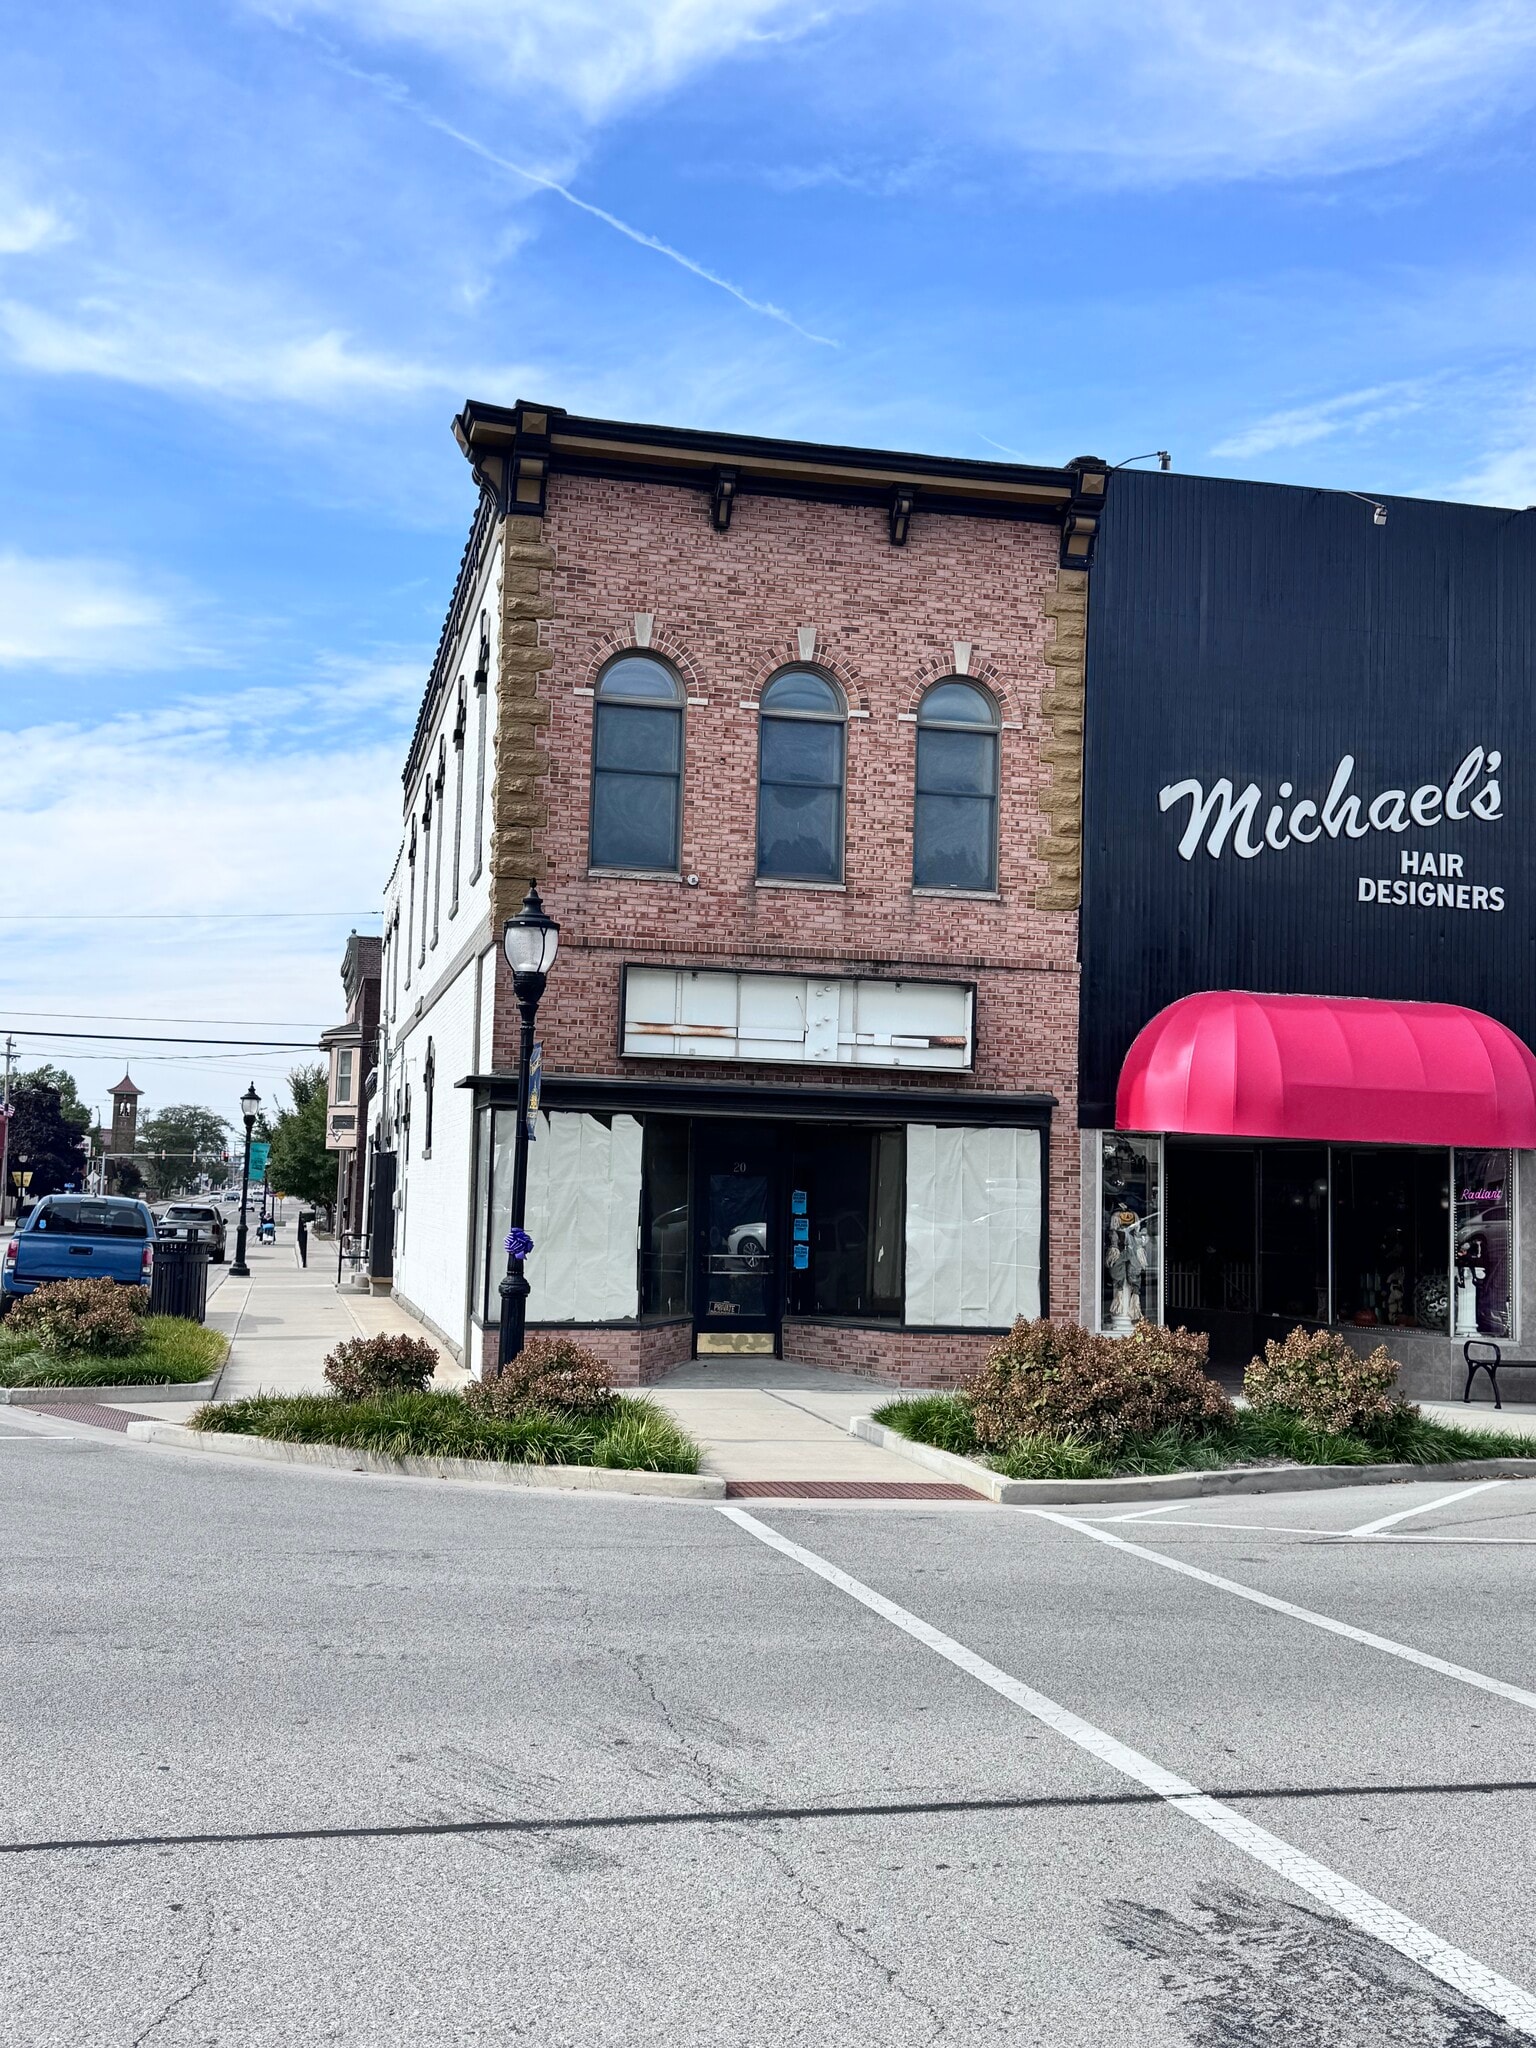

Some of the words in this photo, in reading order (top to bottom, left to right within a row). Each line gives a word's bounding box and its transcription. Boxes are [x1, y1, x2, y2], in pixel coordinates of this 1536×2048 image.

[1159, 745, 1504, 861] Michael's
[1400, 850, 1464, 878] HAIR
[1358, 877, 1505, 912] DESIGNERS
[733, 1162, 747, 1173] 20
[1460, 1187, 1503, 1200] Radiant
